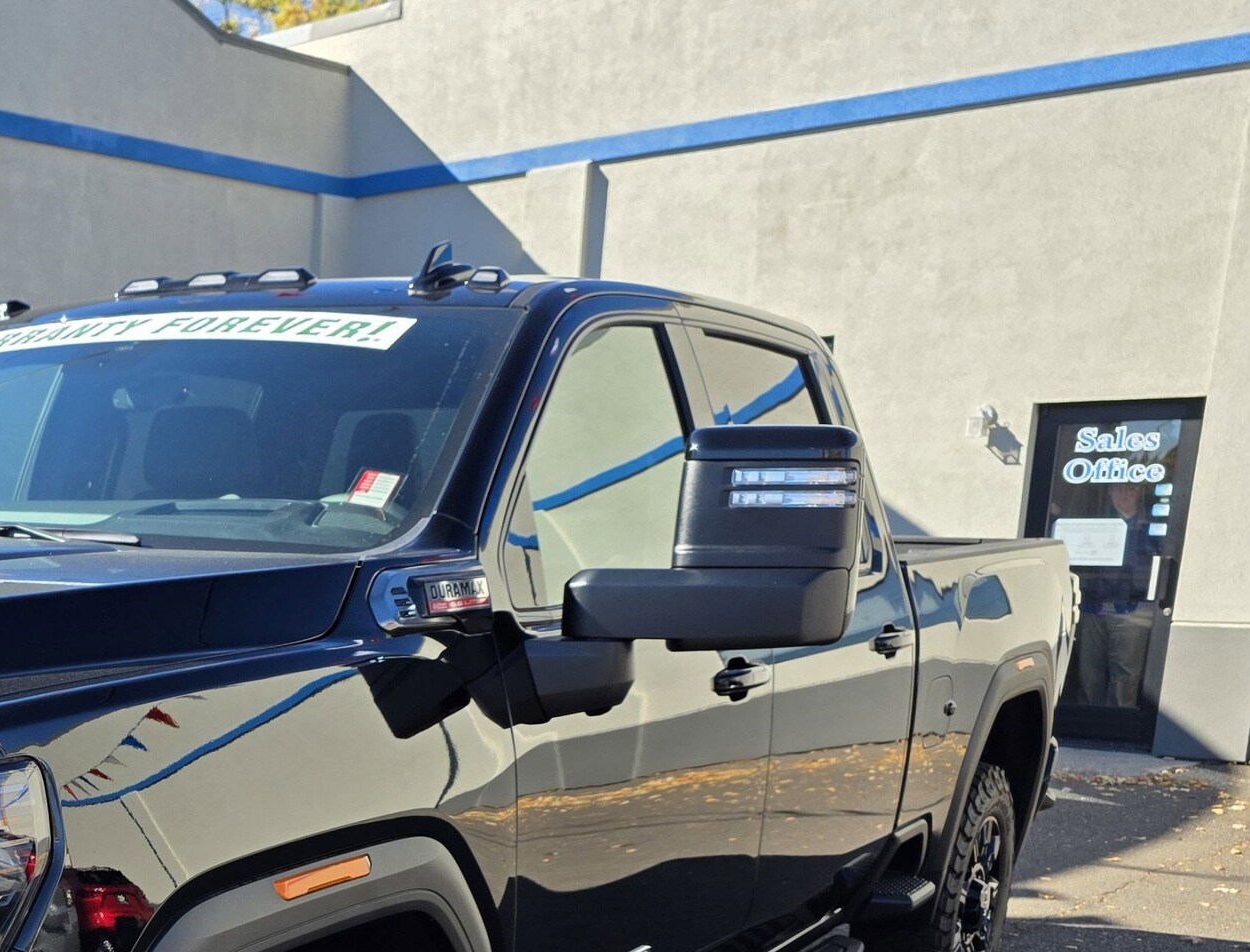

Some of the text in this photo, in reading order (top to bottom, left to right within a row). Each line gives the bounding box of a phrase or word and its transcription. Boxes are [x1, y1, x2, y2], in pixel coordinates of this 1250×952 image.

[151, 316, 398, 342] FOREVER!
[1074, 426, 1161, 453] Sales
[1062, 457, 1166, 484] Office
[430, 580, 485, 599] DURAMAX
